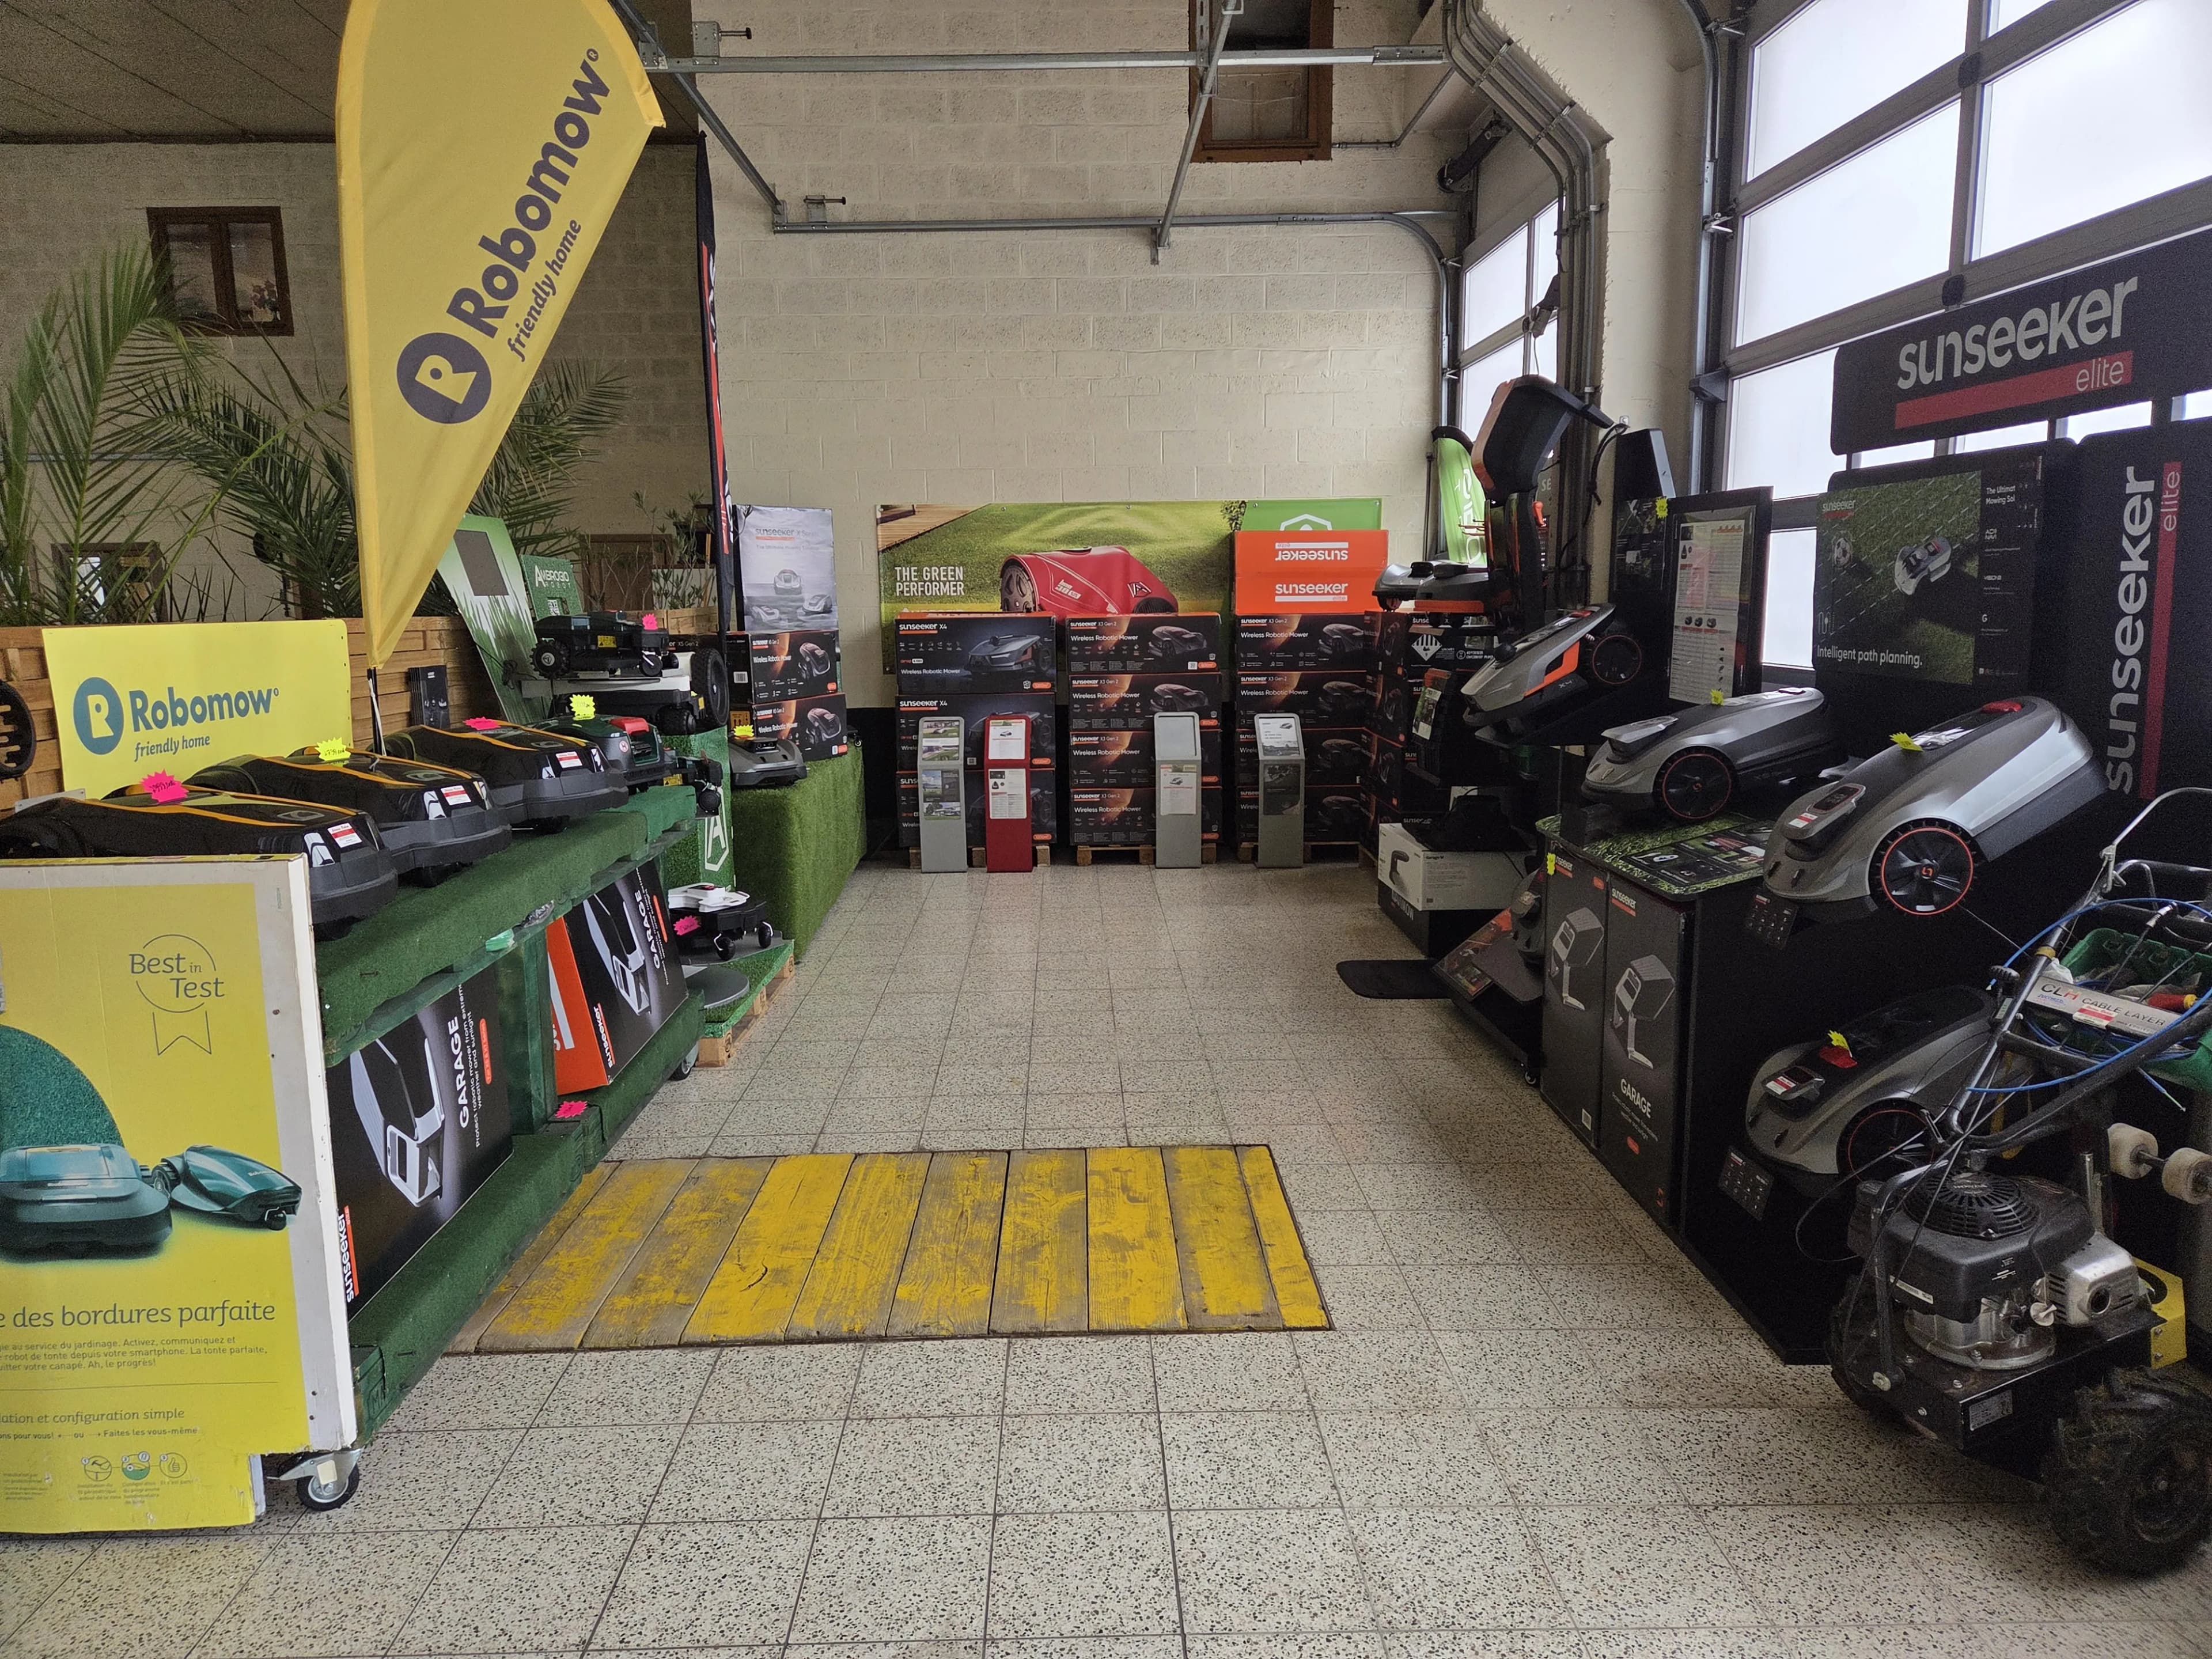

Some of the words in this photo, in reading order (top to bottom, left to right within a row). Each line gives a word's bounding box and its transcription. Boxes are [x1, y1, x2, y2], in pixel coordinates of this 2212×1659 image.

[507, 275, 557, 362] friendly
[543, 219, 582, 277] home
[1897, 276, 2138, 389] sunseeker
[2076, 358, 2124, 392] elite
[1997, 485, 2015, 493] Ultimat
[1822, 500, 1855, 512] sunseeker
[2160, 471, 2180, 532] elite
[1275, 550, 1348, 560] sunseeker
[895, 566, 919, 581] THE
[923, 566, 964, 581] GREEN
[896, 582, 964, 597] PERFORMER
[1275, 584, 1348, 594] sunseeker
[2107, 466, 2155, 794] sunseeker
[1817, 645, 1856, 662] Intelligent
[1858, 649, 1878, 664] path
[1880, 650, 1923, 669] planning.
[1558, 680, 1573, 689] X4
[134, 738, 179, 762] friendly
[181, 734, 210, 752] home
[635, 889, 661, 969] GARAGE
[129, 953, 186, 974] Best
[190, 961, 202, 974] in
[170, 978, 225, 998] Test
[2082, 997, 2124, 1014] CABLE
[2124, 1010, 2166, 1027] LAYER
[467, 1011, 476, 1047] sunlight
[593, 1006, 613, 1069] sunseeker
[448, 1016, 469, 1128] GARAGE
[1620, 1078, 1651, 1118] GARAGE
[339, 1213, 354, 1303] sunseeker
[13, 1306, 54, 1328] des
[61, 1302, 172, 1327] bordures
[178, 1300, 276, 1328] parfaite
[5, 1353, 28, 1361] robot
[31, 1353, 41, 1361] de
[44, 1353, 67, 1361] tonte
[70, 1351, 101, 1362] depuis
[130, 1347, 188, 1358] smartphone.
[230, 1346, 268, 1355] parfaite,
[25, 1343, 57, 1351] service
[74, 1339, 120, 1351] jardinage.
[123, 1338, 158, 1347] Activez,
[161, 1336, 225, 1347] communiquez
[24, 1363, 47, 1371] votre
[49, 1360, 85, 1371] canapé.
[88, 1359, 104, 1369] Ah,
[105, 1359, 115, 1368] le
[117, 1358, 156, 1370] progrès!
[37, 1414, 49, 1423] et
[53, 1410, 139, 1425] configuration
[143, 1408, 185, 1421] simple
[13, 1433, 31, 1441] pour
[103, 1429, 130, 1438] Faites
[132, 1428, 145, 1436] les
